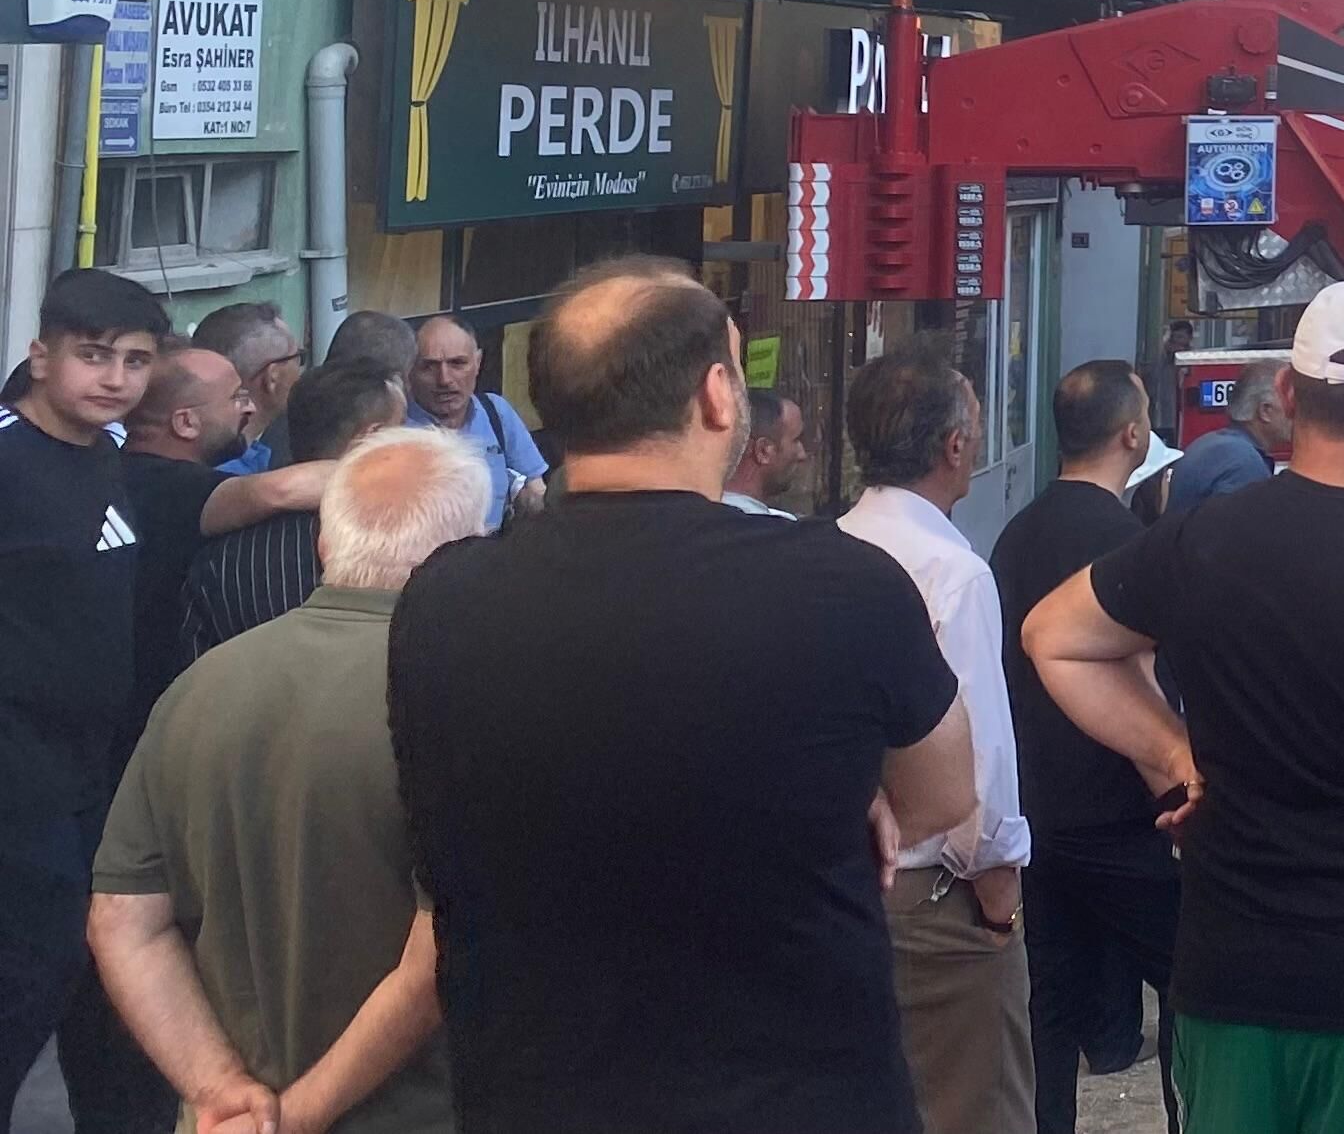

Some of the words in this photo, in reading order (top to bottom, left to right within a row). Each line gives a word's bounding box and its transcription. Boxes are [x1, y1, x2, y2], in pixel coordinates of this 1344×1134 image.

[162, 0, 258, 37] AVUKAT
[162, 47, 192, 68] Esra
[196, 43, 254, 73] ŞAHİNER
[497, 83, 674, 156] PERDE
[1197, 144, 1268, 154] AUTOMATION
